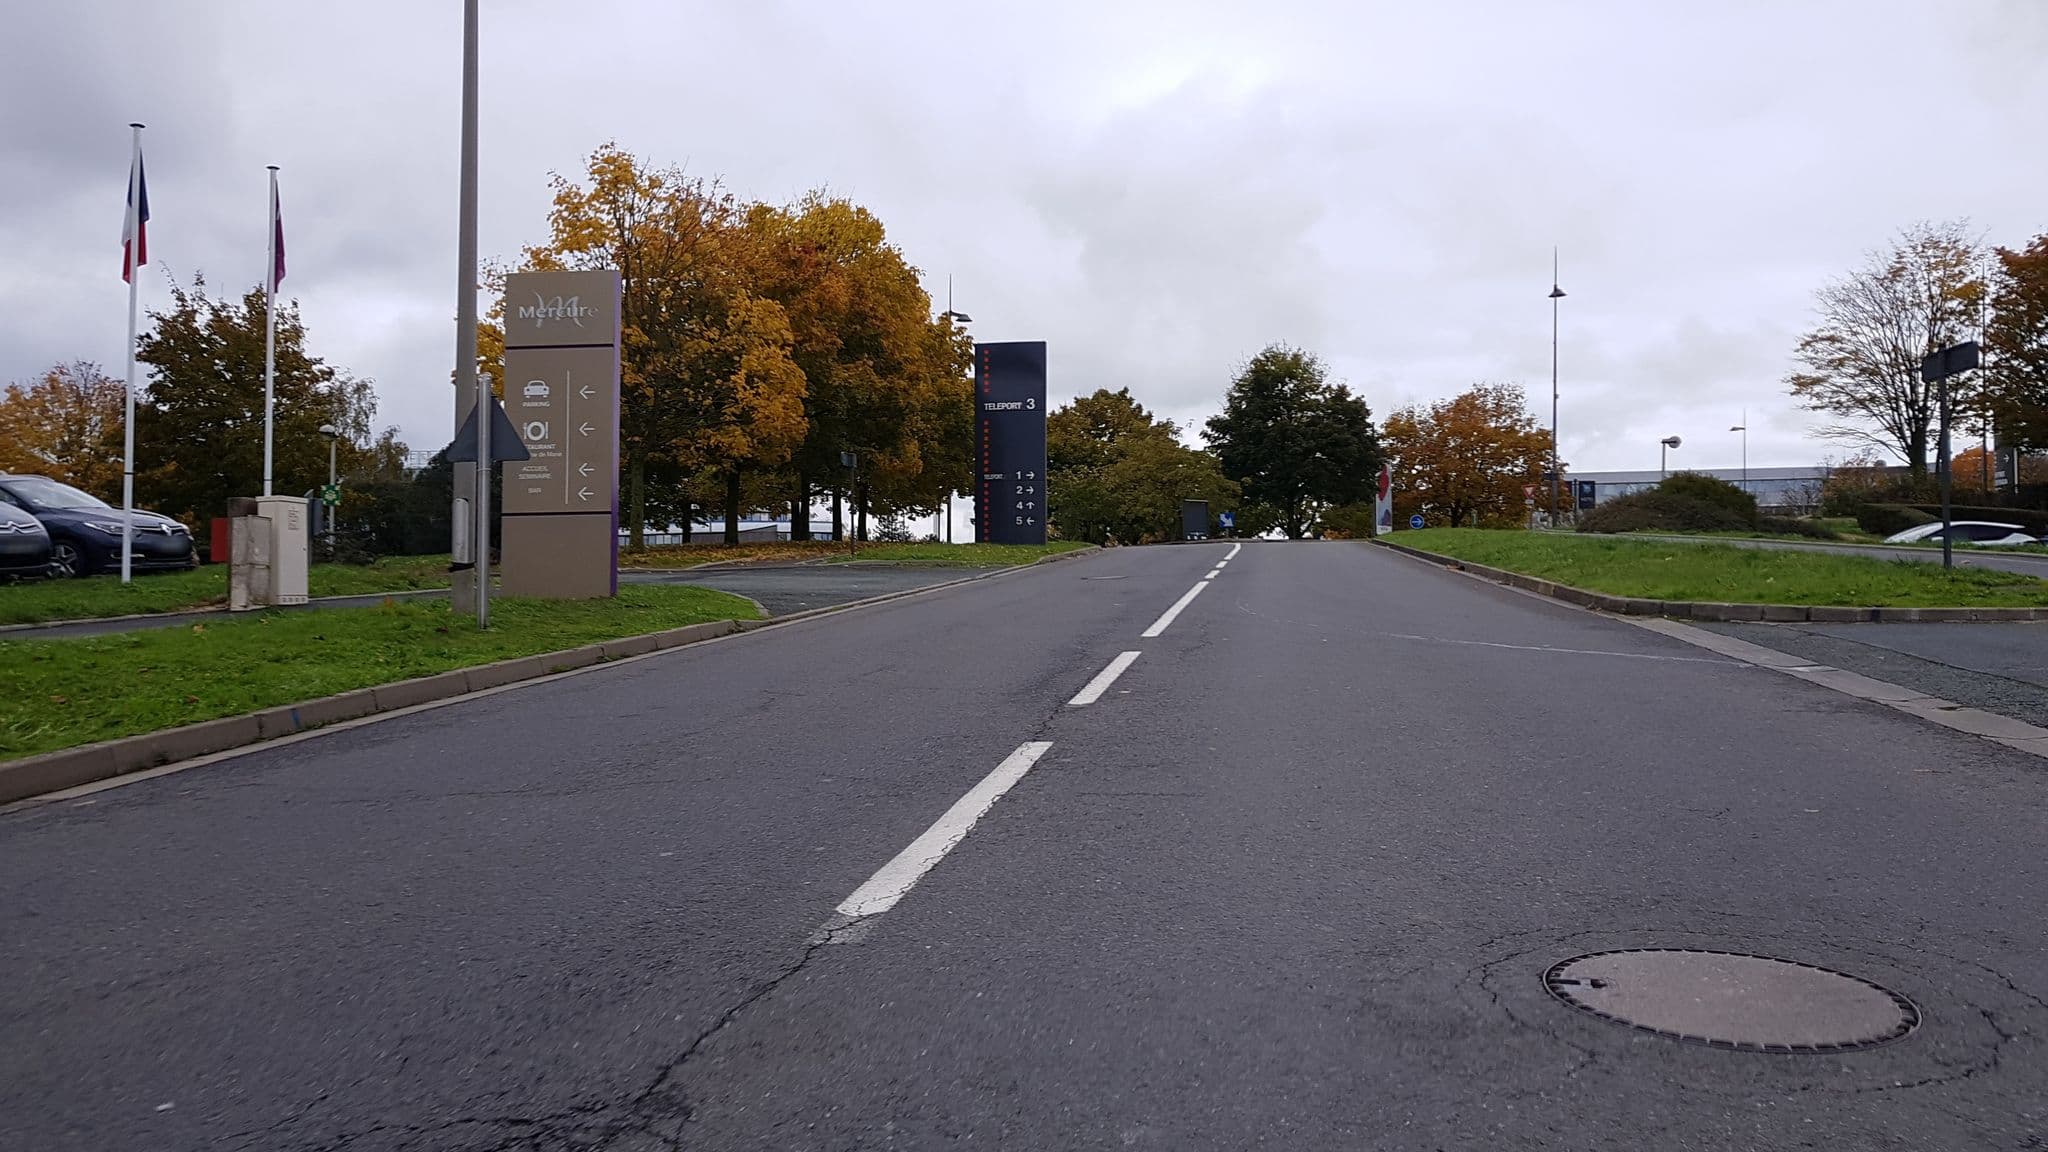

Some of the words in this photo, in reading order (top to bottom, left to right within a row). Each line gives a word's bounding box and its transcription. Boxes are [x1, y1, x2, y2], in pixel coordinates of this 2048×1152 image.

[519, 305, 599, 319] Mercure
[984, 402, 1022, 410] TELEPORT
[1026, 398, 1036, 410] 3
[1015, 470, 1022, 480] 1
[1016, 485, 1023, 495] 2
[1016, 501, 1023, 510] 4
[1015, 516, 1023, 525] 5
